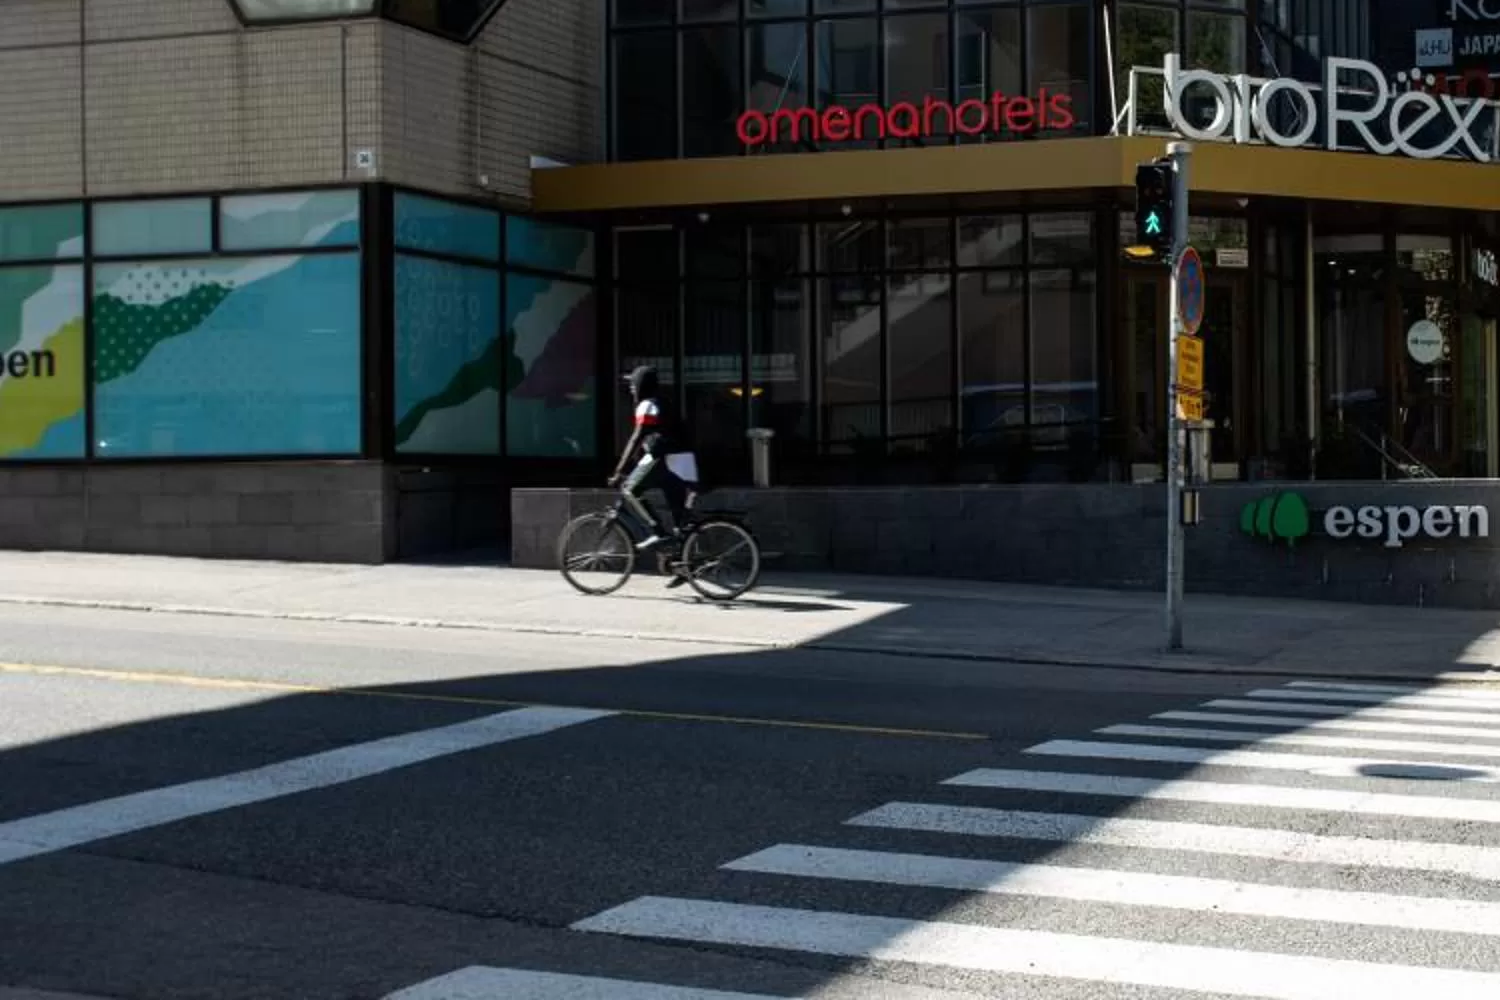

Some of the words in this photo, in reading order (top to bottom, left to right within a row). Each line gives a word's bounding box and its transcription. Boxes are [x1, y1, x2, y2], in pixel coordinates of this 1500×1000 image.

[735, 87, 1074, 145] omenahotels
[0, 350, 55, 378] en
[1324, 502, 1489, 546] espen
